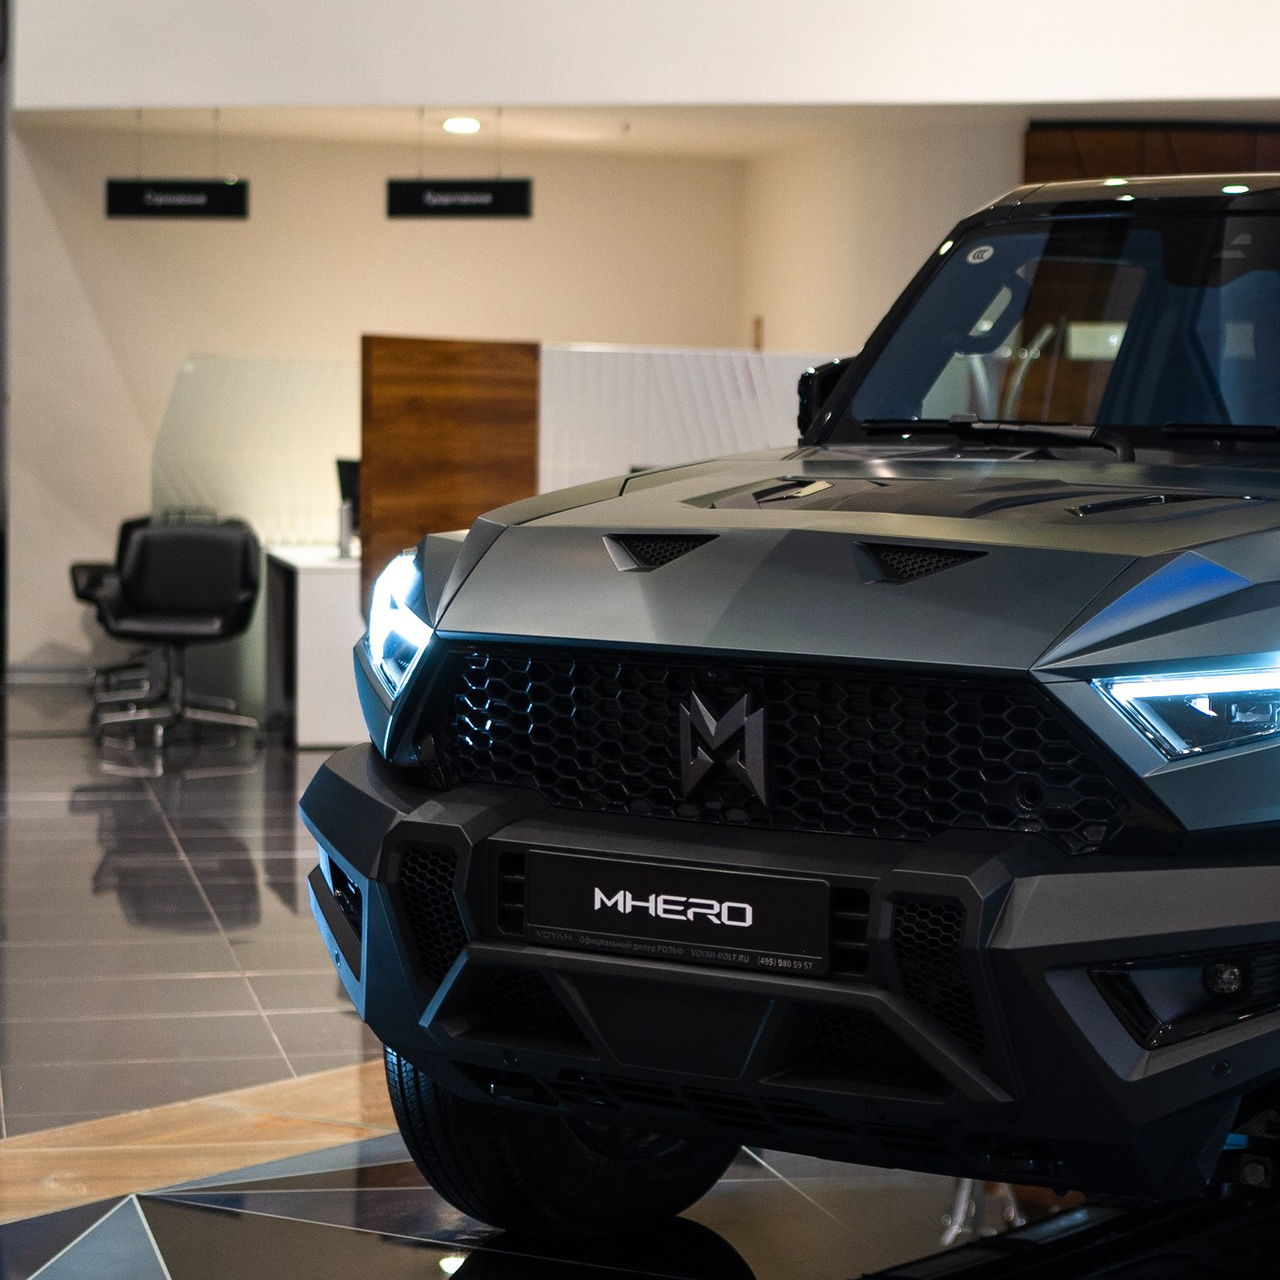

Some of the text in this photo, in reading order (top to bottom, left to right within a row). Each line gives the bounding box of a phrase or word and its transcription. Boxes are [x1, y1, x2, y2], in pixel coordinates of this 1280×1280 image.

[594, 886, 753, 927] MHERO
[657, 944, 684, 955] РОЛЬФ
[691, 948, 813, 970] VOYAH-ROLF.RU (495) 980 59 57
